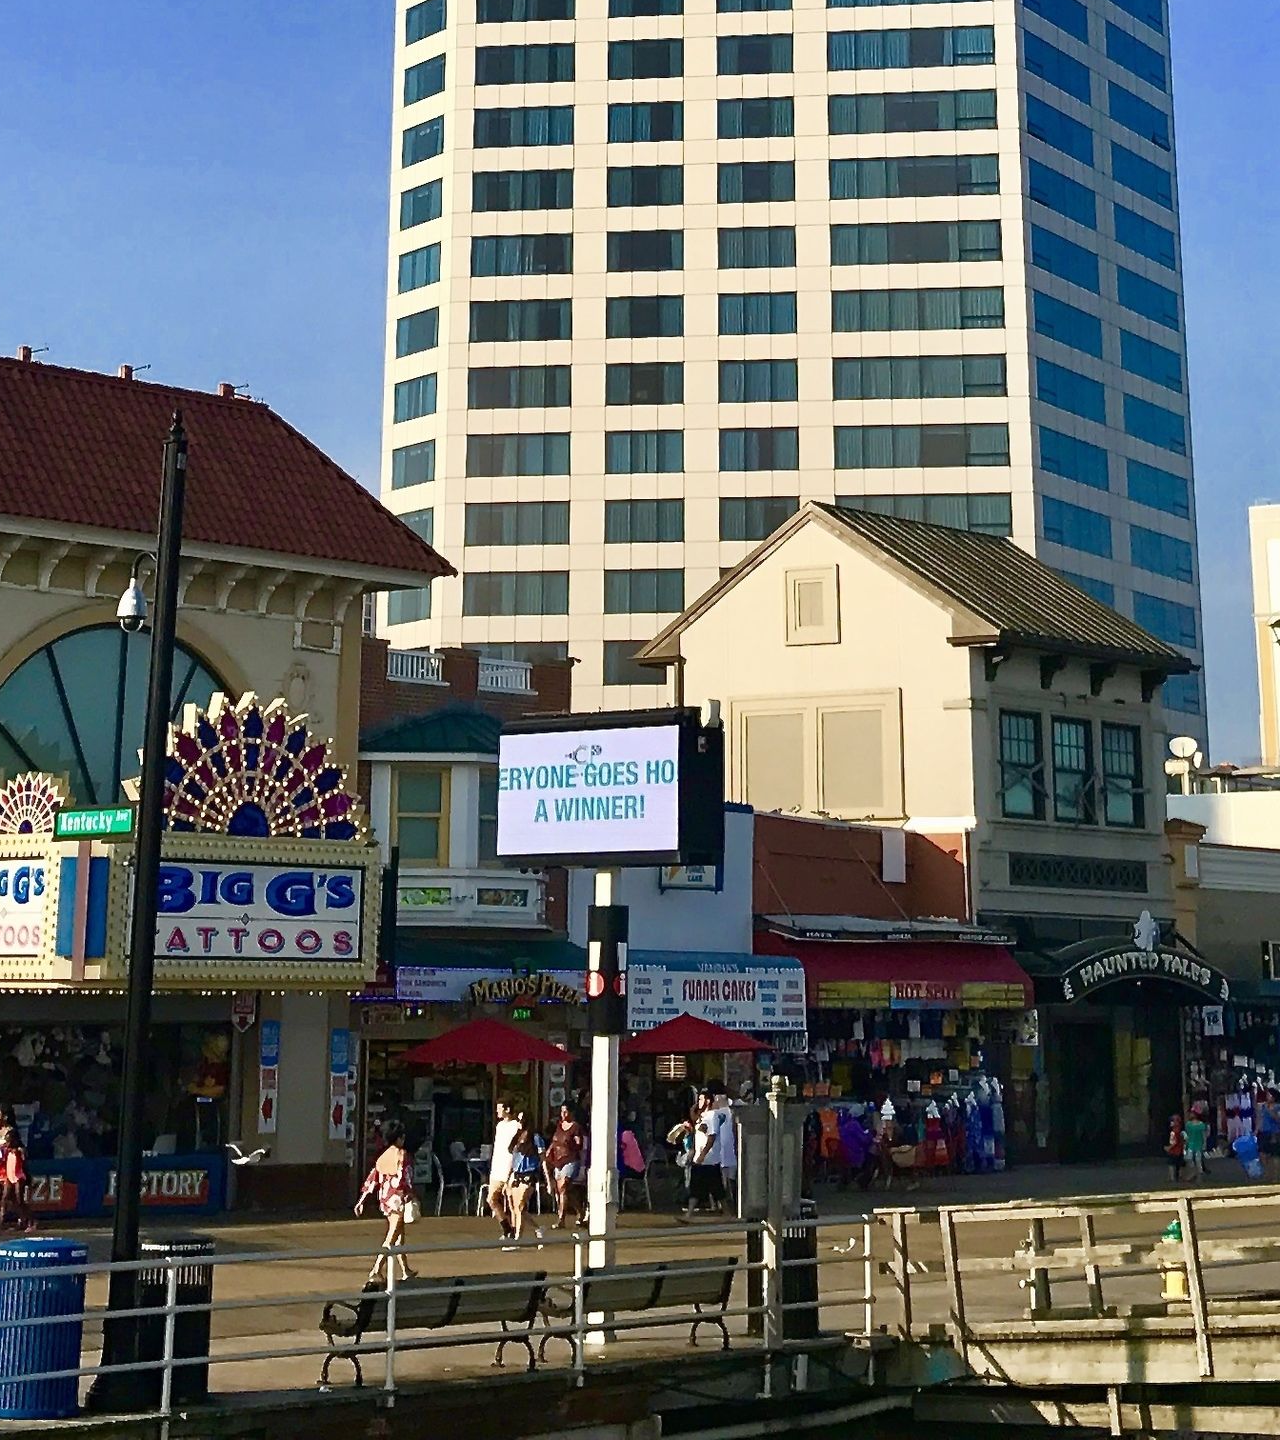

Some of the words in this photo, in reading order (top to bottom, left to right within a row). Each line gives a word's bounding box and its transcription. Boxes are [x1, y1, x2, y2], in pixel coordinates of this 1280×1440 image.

[584, 762, 639, 788] GOES
[60, 811, 113, 833] Kentucky
[115, 810, 129, 822] Ave
[533, 798, 549, 823] A
[554, 794, 646, 822] WINNER!
[157, 865, 255, 914] BIG
[155, 926, 354, 956] ATTOOS
[1079, 951, 1158, 987] HAUNTED
[1160, 953, 1212, 986] TALES
[472, 974, 537, 1006] MARIO'S
[538, 973, 581, 1006] PIZZA
[682, 979, 719, 1002] FUNNEL
[722, 979, 756, 1002] CAKES
[24, 1174, 63, 1202] IZE
[108, 1169, 208, 1197] FCTORY
